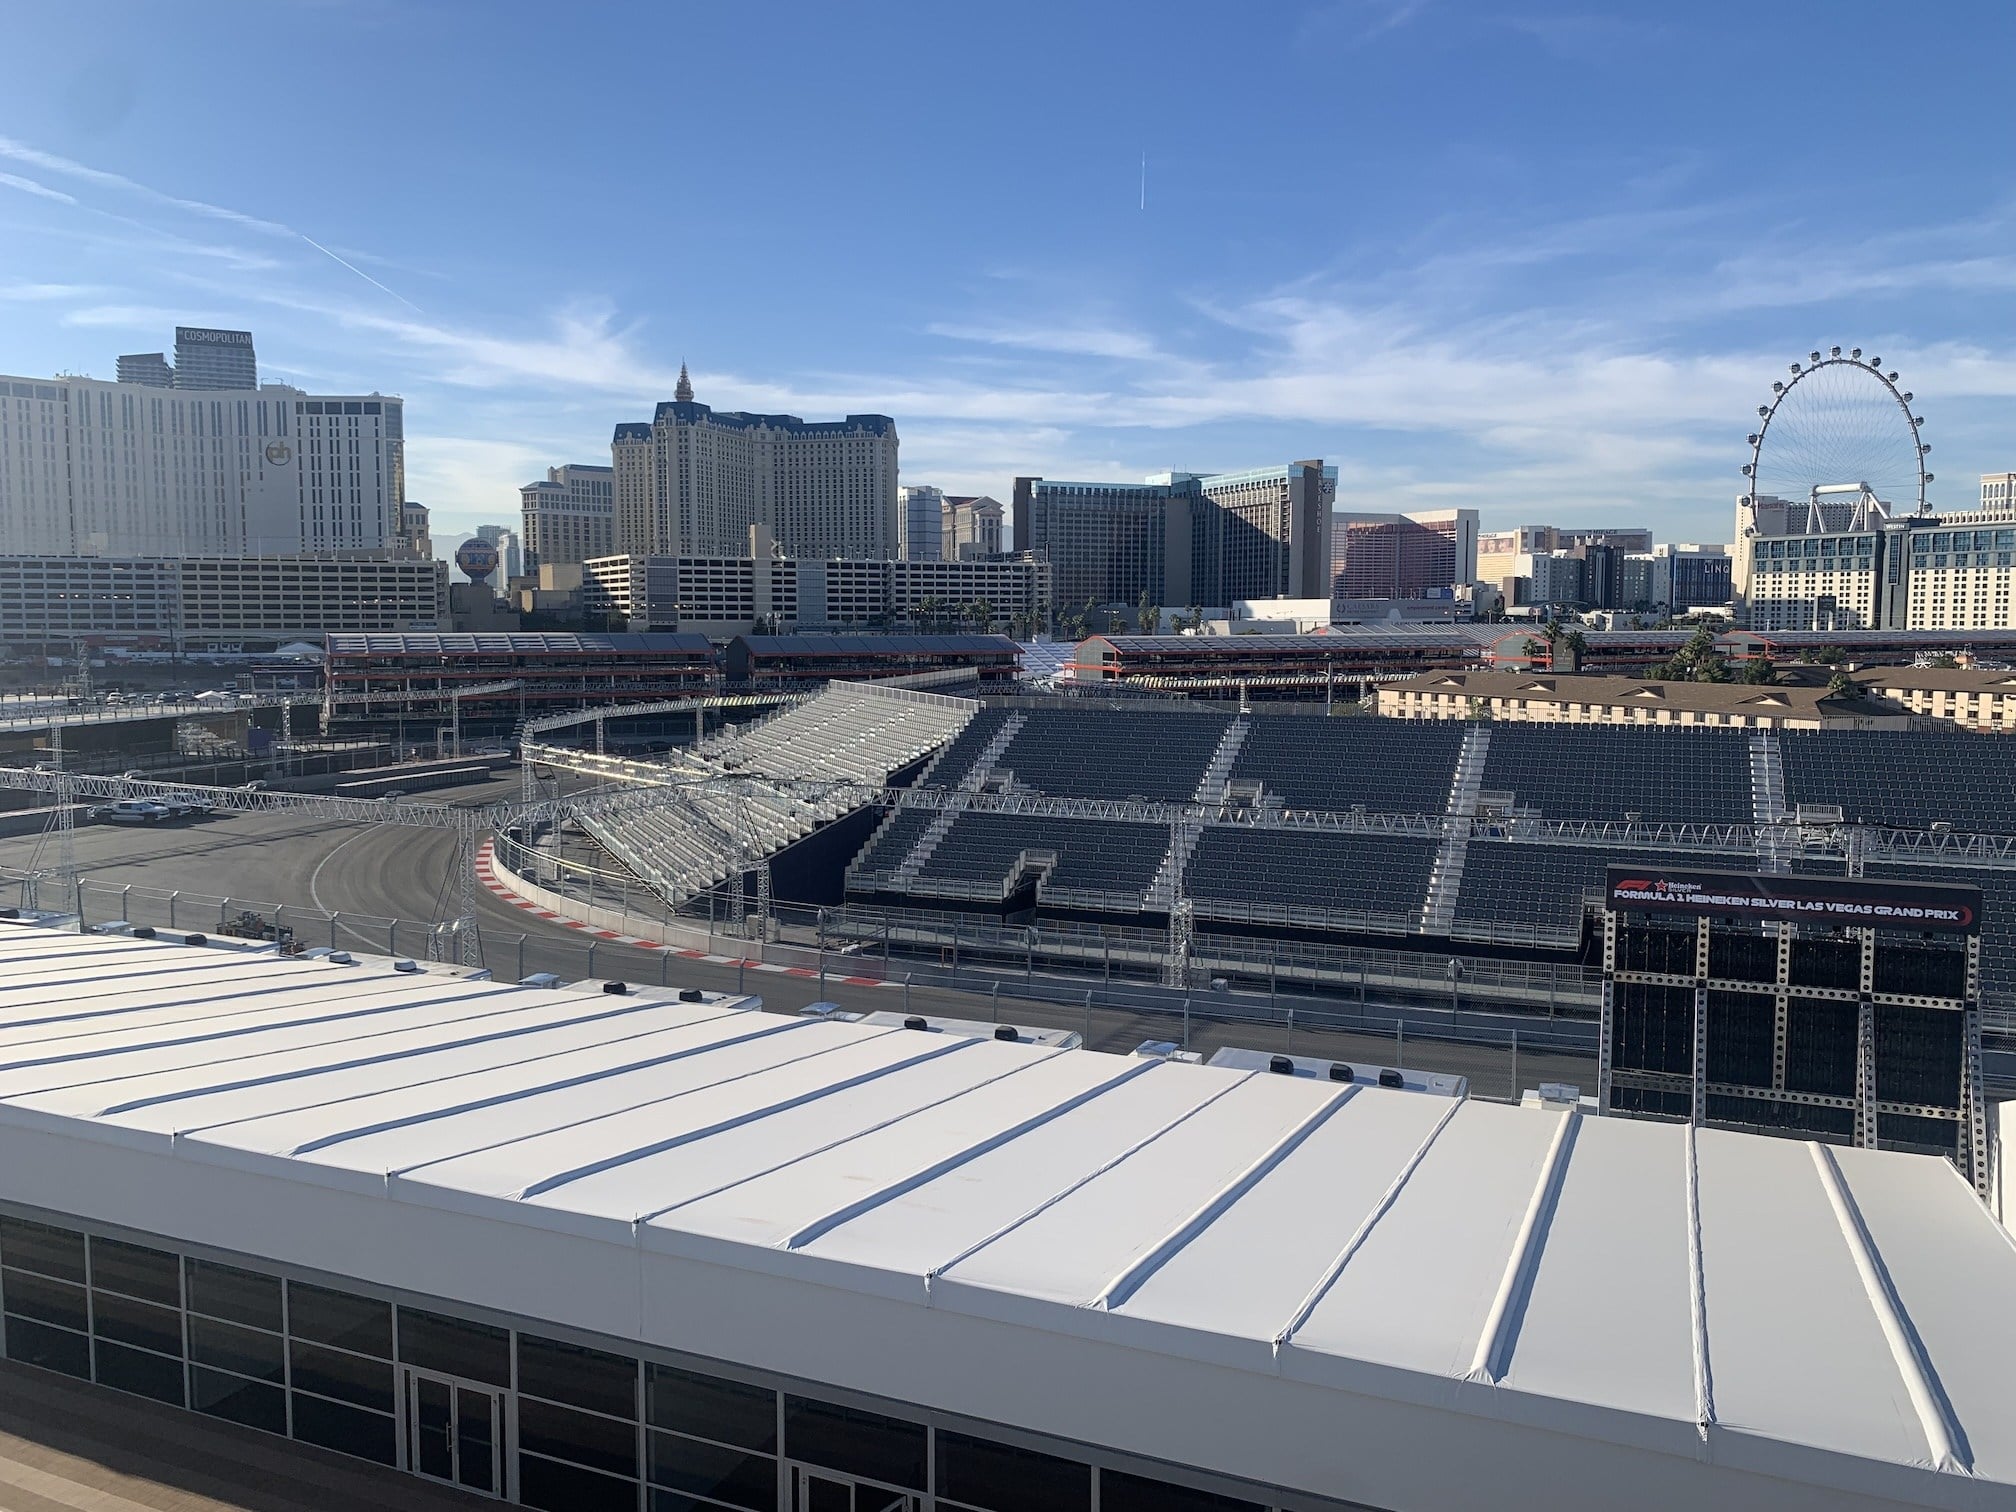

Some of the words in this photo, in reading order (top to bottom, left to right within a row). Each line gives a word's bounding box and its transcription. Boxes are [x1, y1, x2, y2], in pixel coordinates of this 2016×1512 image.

[184, 330, 252, 344] COSMOPOLITAN
[1704, 565, 1730, 574] LINQ
[1668, 881, 1702, 891] Heineken
[1614, 889, 1675, 902] FORMULA
[1677, 894, 1685, 902] 1
[1686, 894, 1750, 907] HEINEKEN
[1750, 898, 1796, 910] SILVER
[1797, 900, 1824, 911] LAS
[1825, 903, 1873, 914] VEGAS
[1874, 905, 1924, 918] GRAND
[1924, 908, 1959, 920] PRIX
